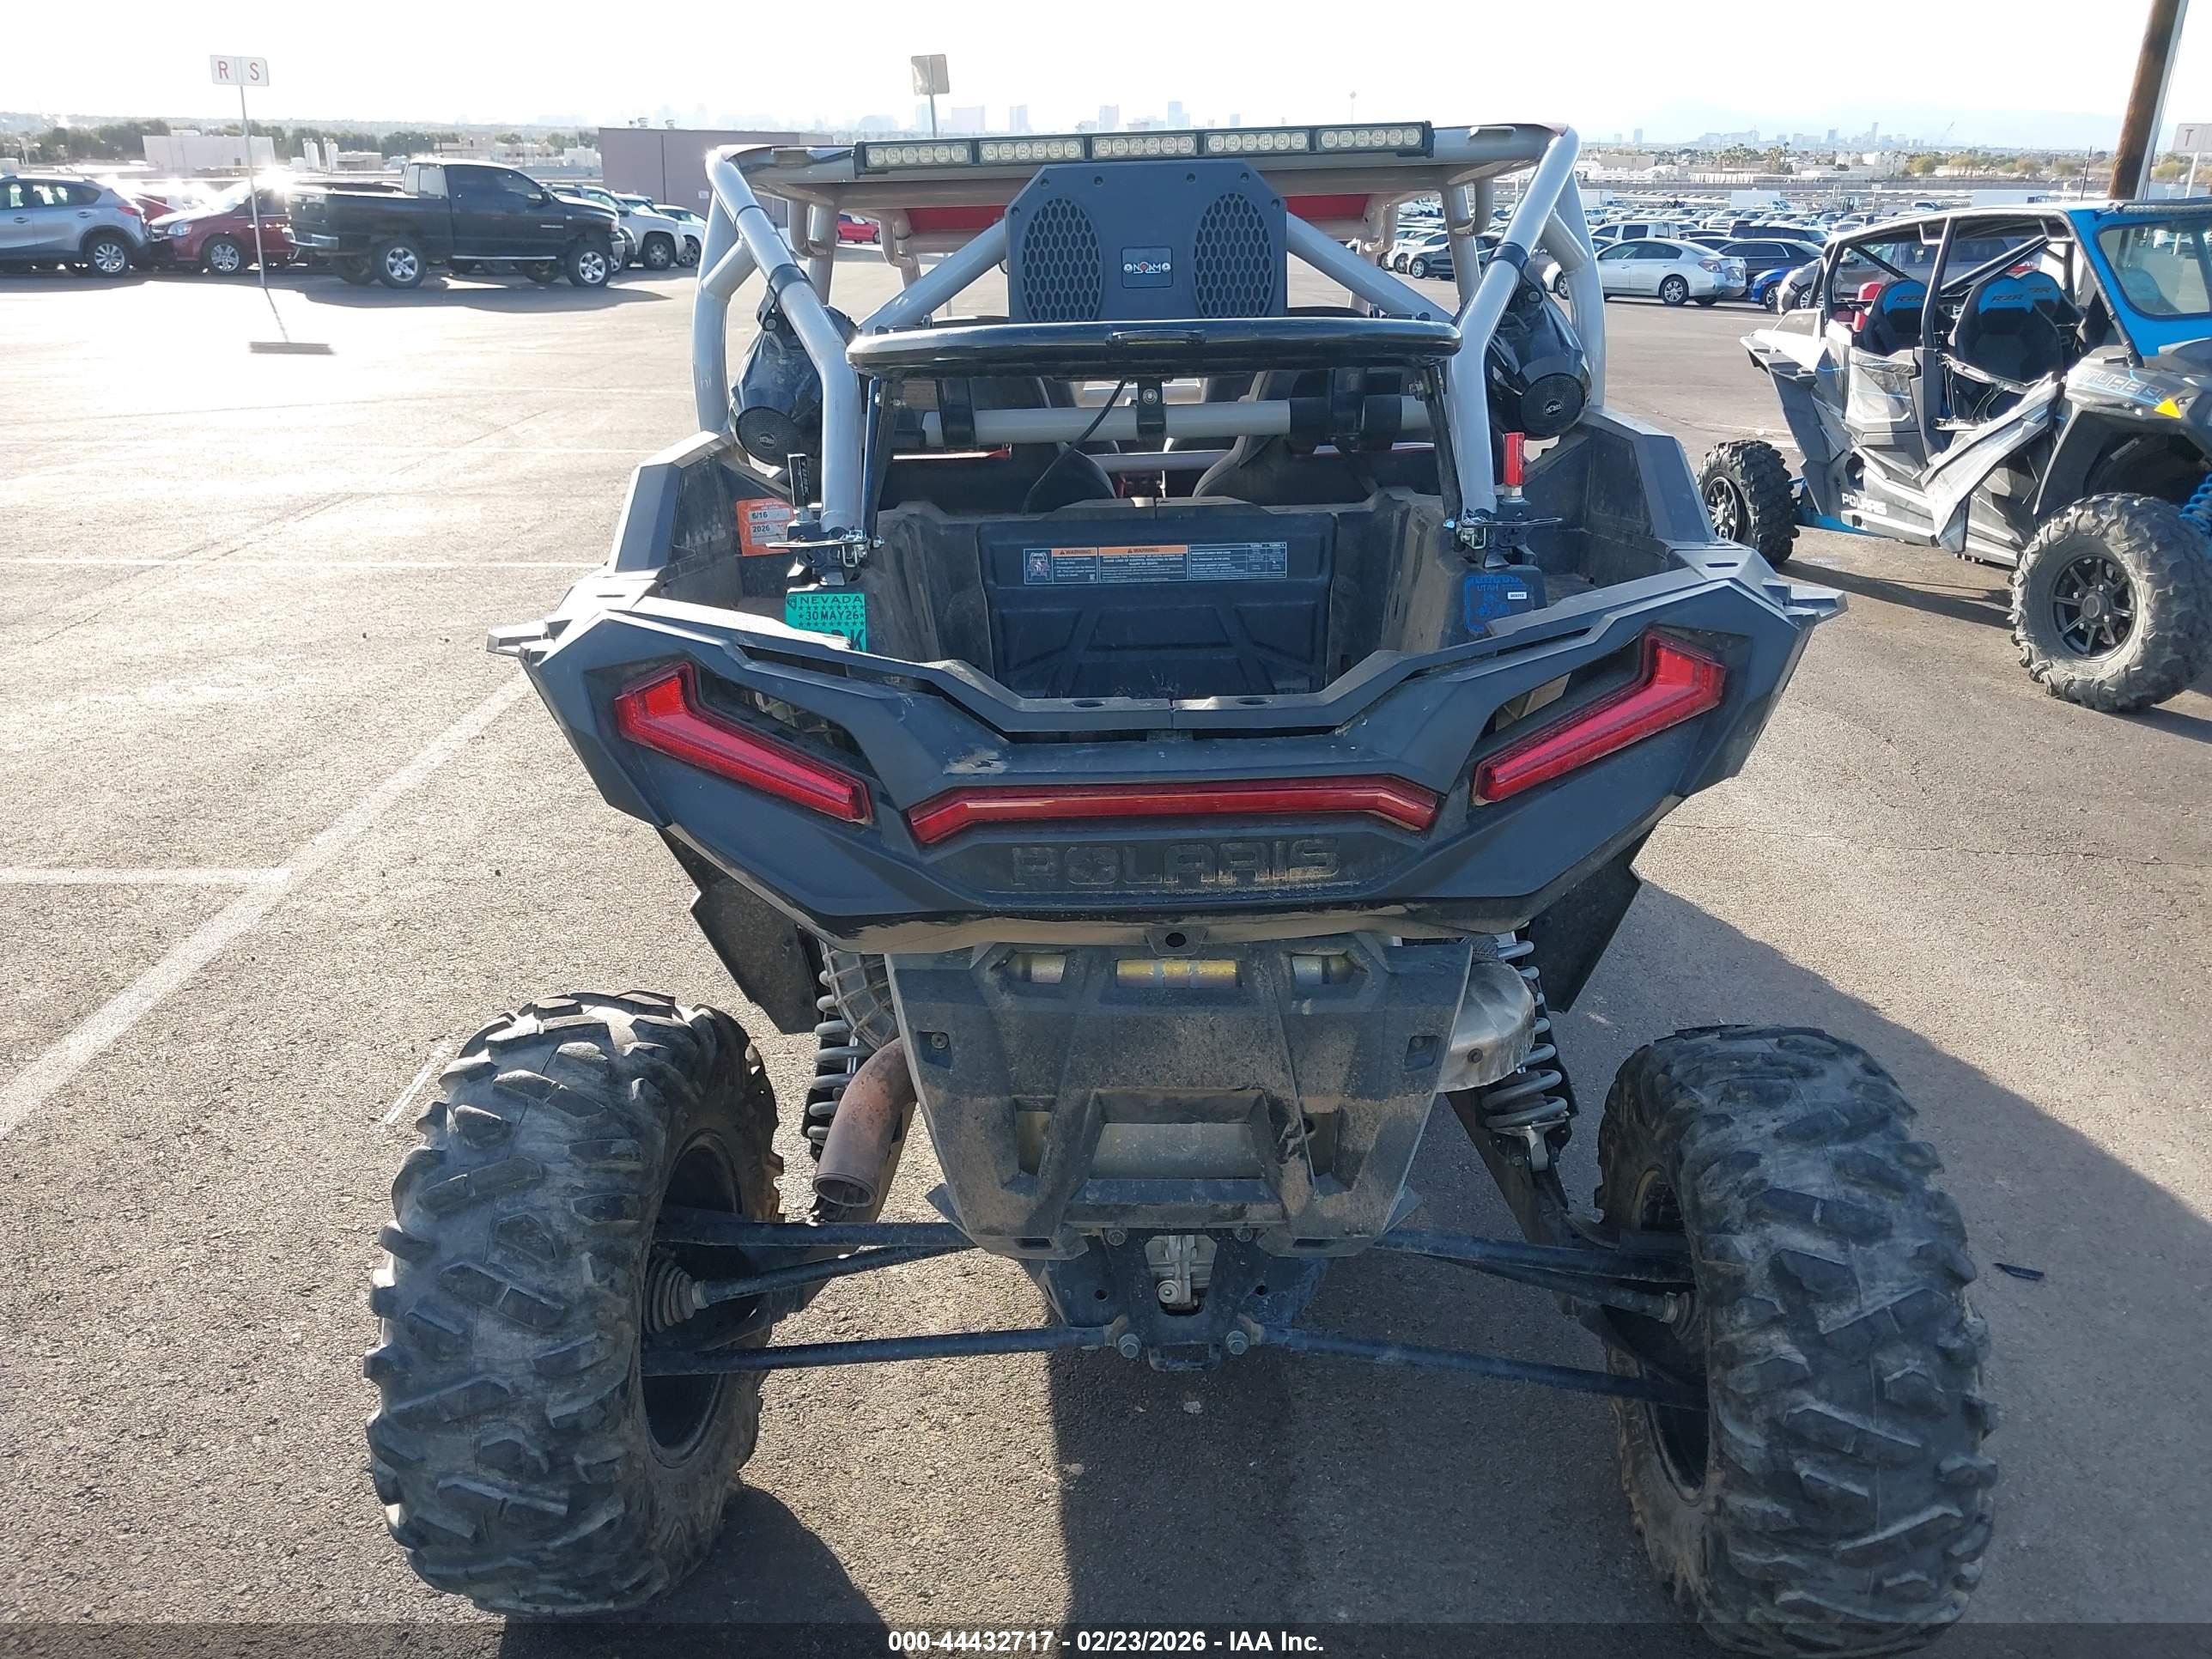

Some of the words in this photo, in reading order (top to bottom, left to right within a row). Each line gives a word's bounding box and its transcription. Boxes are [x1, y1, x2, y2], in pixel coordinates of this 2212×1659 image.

[217, 60, 229, 80] R
[249, 62, 260, 81] S
[2185, 129, 2195, 147] T
[1991, 294, 2025, 303] RZR
[1841, 492, 1888, 516] POLARIS
[752, 525, 770, 533] 2026
[1477, 583, 1498, 592] UTAH
[799, 595, 863, 605] NEVADA
[1012, 837, 1340, 886] POLARIS
